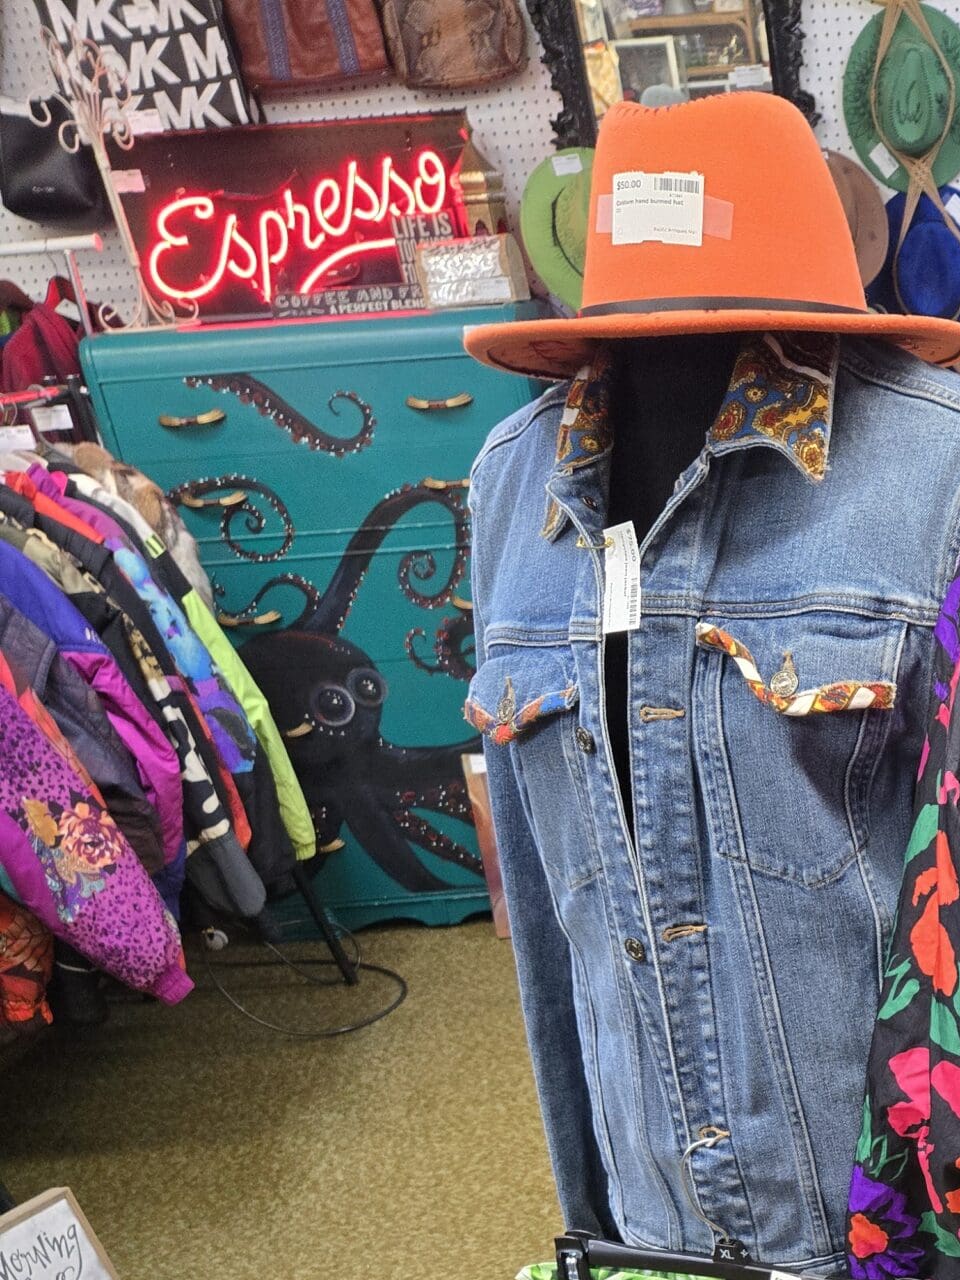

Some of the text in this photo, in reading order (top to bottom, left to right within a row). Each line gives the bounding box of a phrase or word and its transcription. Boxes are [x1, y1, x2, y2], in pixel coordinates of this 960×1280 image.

[616, 179, 642, 191] $50.00
[149, 150, 446, 303] Espresso
[391, 211, 453, 239] LIFE IS
[355, 285, 394, 302] AND
[720, 1249, 735, 1260] XL
